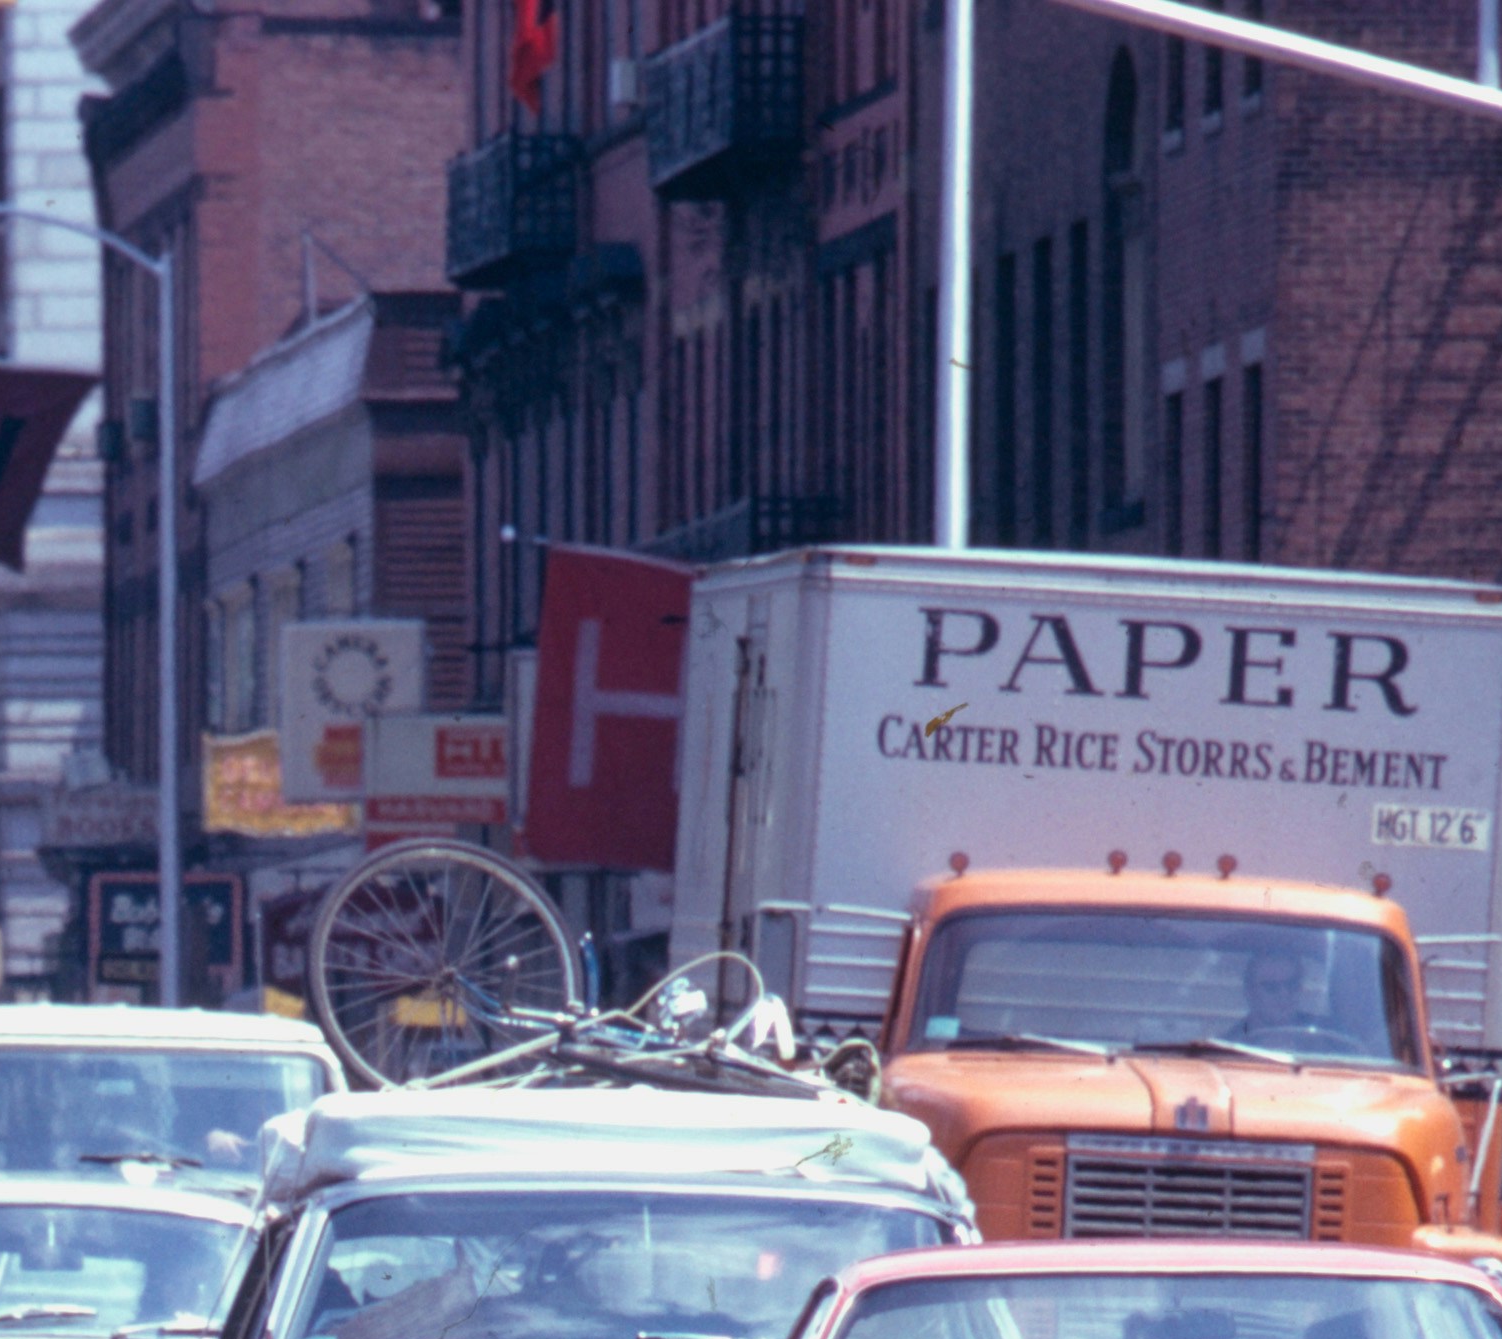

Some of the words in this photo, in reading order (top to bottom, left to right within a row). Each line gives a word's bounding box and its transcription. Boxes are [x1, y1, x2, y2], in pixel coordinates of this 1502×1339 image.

[913, 605, 1419, 717] PAPER
[876, 713, 1020, 766] CARTER
[1033, 723, 1120, 772] RICE
[1131, 729, 1275, 782] STORRS
[1278, 758, 1297, 783] &
[1301, 739, 1449, 791] BEMENT
